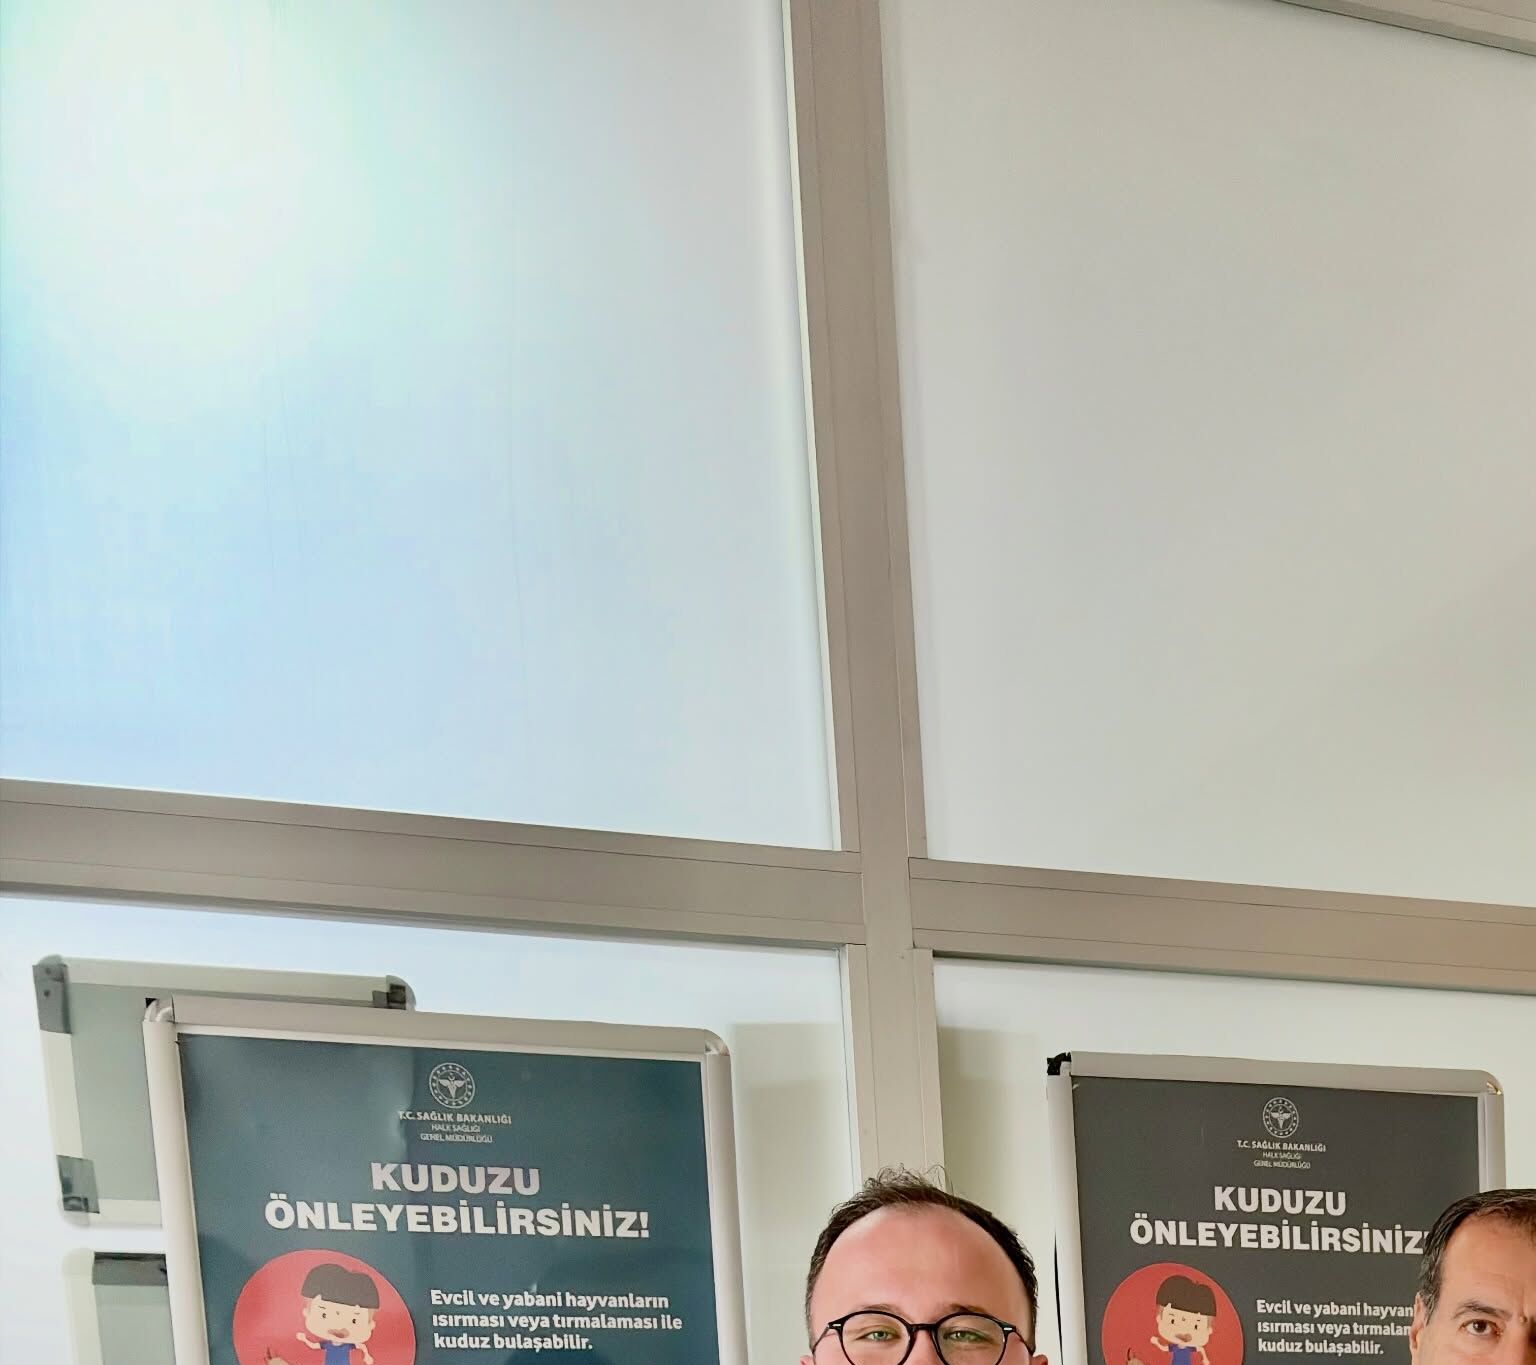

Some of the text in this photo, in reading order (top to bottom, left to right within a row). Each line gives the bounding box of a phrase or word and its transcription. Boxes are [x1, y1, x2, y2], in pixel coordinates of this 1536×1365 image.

[417, 1110, 454, 1122] SAĞLIK
[456, 1113, 512, 1124] BAKANLIĞI
[370, 1162, 540, 1196] KUDUZU
[1214, 1186, 1346, 1216] KUDUZU
[264, 1192, 650, 1239] ÖNLEYEBİLİRSİNİZ!
[431, 1289, 669, 1311] Evcil ve yabani hayvanların
[1256, 1299, 1415, 1320] Evcil ve yabani hayvan
[432, 1313, 683, 1332] ısırması veya tırmalaması ile
[1257, 1321, 1315, 1334] ısırması
[1316, 1322, 1350, 1338] veya
[433, 1332, 593, 1352] kuduz bulaşabilir.
[1257, 1338, 1384, 1357] kuduz bulaşabilir.
